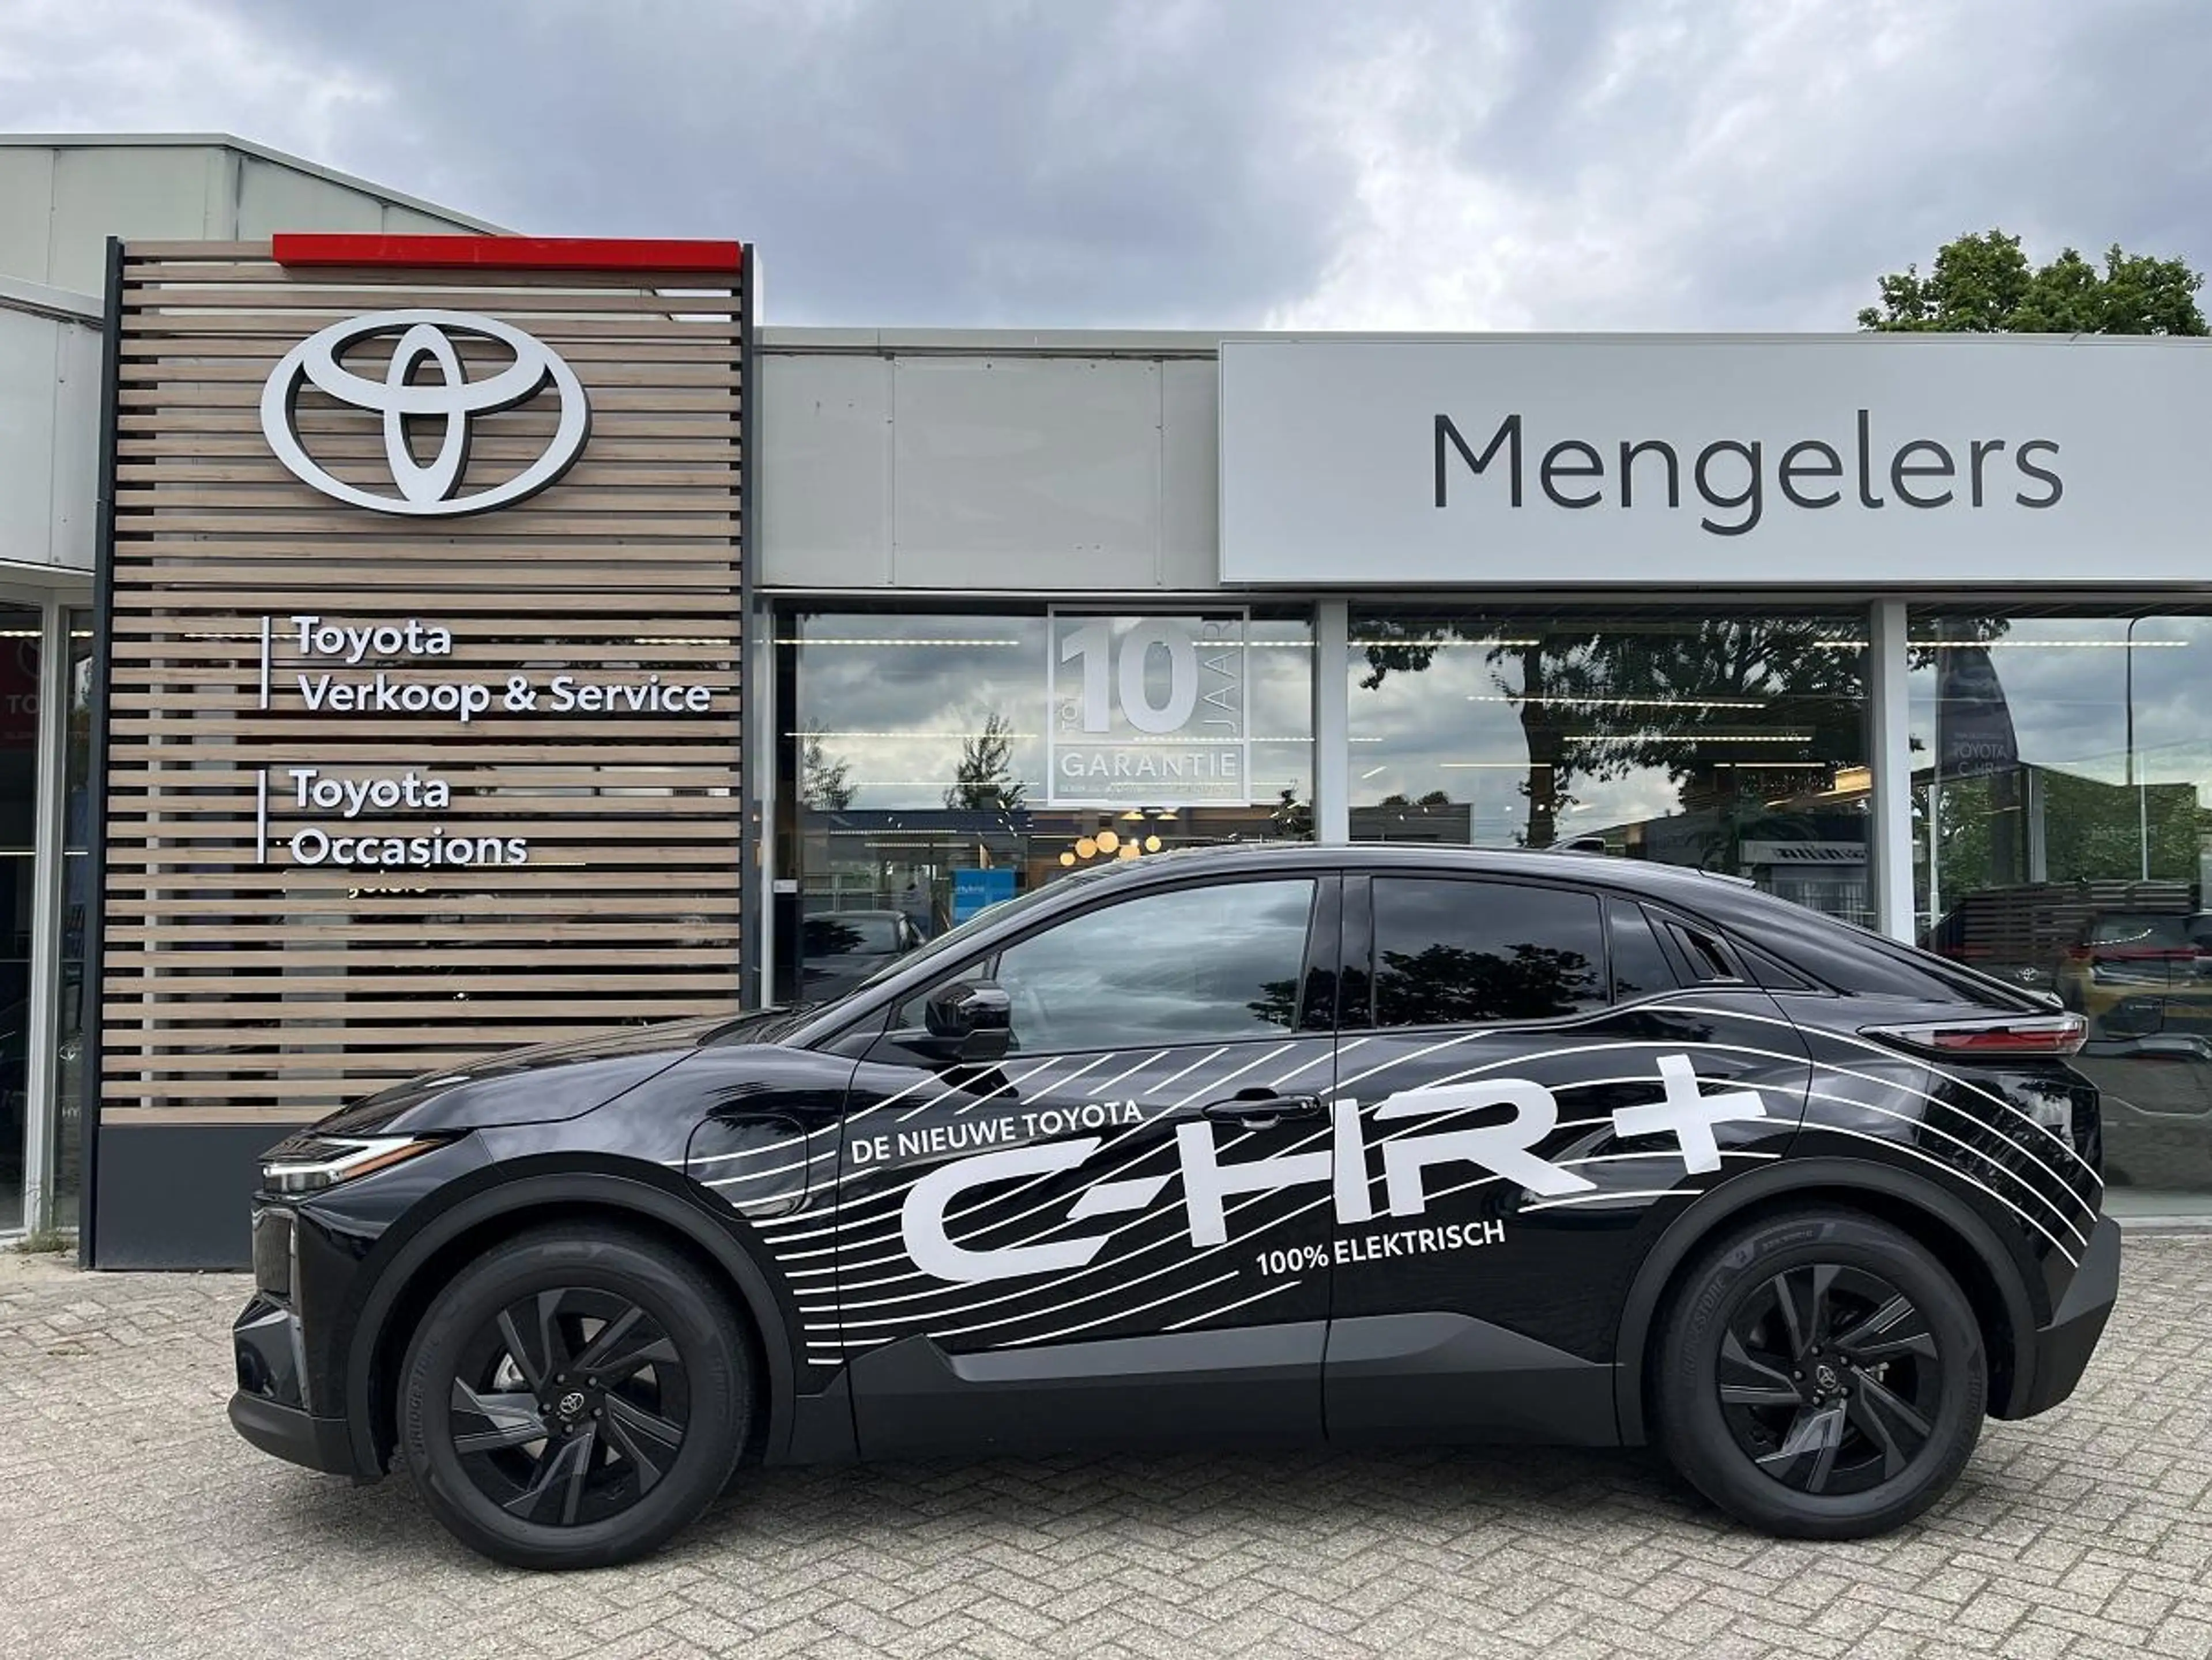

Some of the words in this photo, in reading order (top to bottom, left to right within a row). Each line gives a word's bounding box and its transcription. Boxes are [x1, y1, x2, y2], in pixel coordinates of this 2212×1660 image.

[1434, 409, 2064, 536] Mengelers
[291, 616, 451, 663] Toyota
[297, 673, 490, 722] Verkoop
[503, 676, 537, 711] &
[550, 674, 711, 712] Service
[1061, 619, 1199, 735] 10
[1201, 619, 1239, 734] JAAR
[288, 769, 450, 818] Toyota
[1060, 752, 1237, 778] GARANTIE
[291, 826, 529, 865] Occasions
[851, 1135, 890, 1164] DE
[898, 1116, 1016, 1157] NIEUWE
[1022, 1100, 1144, 1137] TOYOTA
[902, 1054, 1767, 1282] C-HR+
[1256, 1244, 1329, 1276] 100%
[1333, 1219, 1505, 1265] ELEKTRISCH
